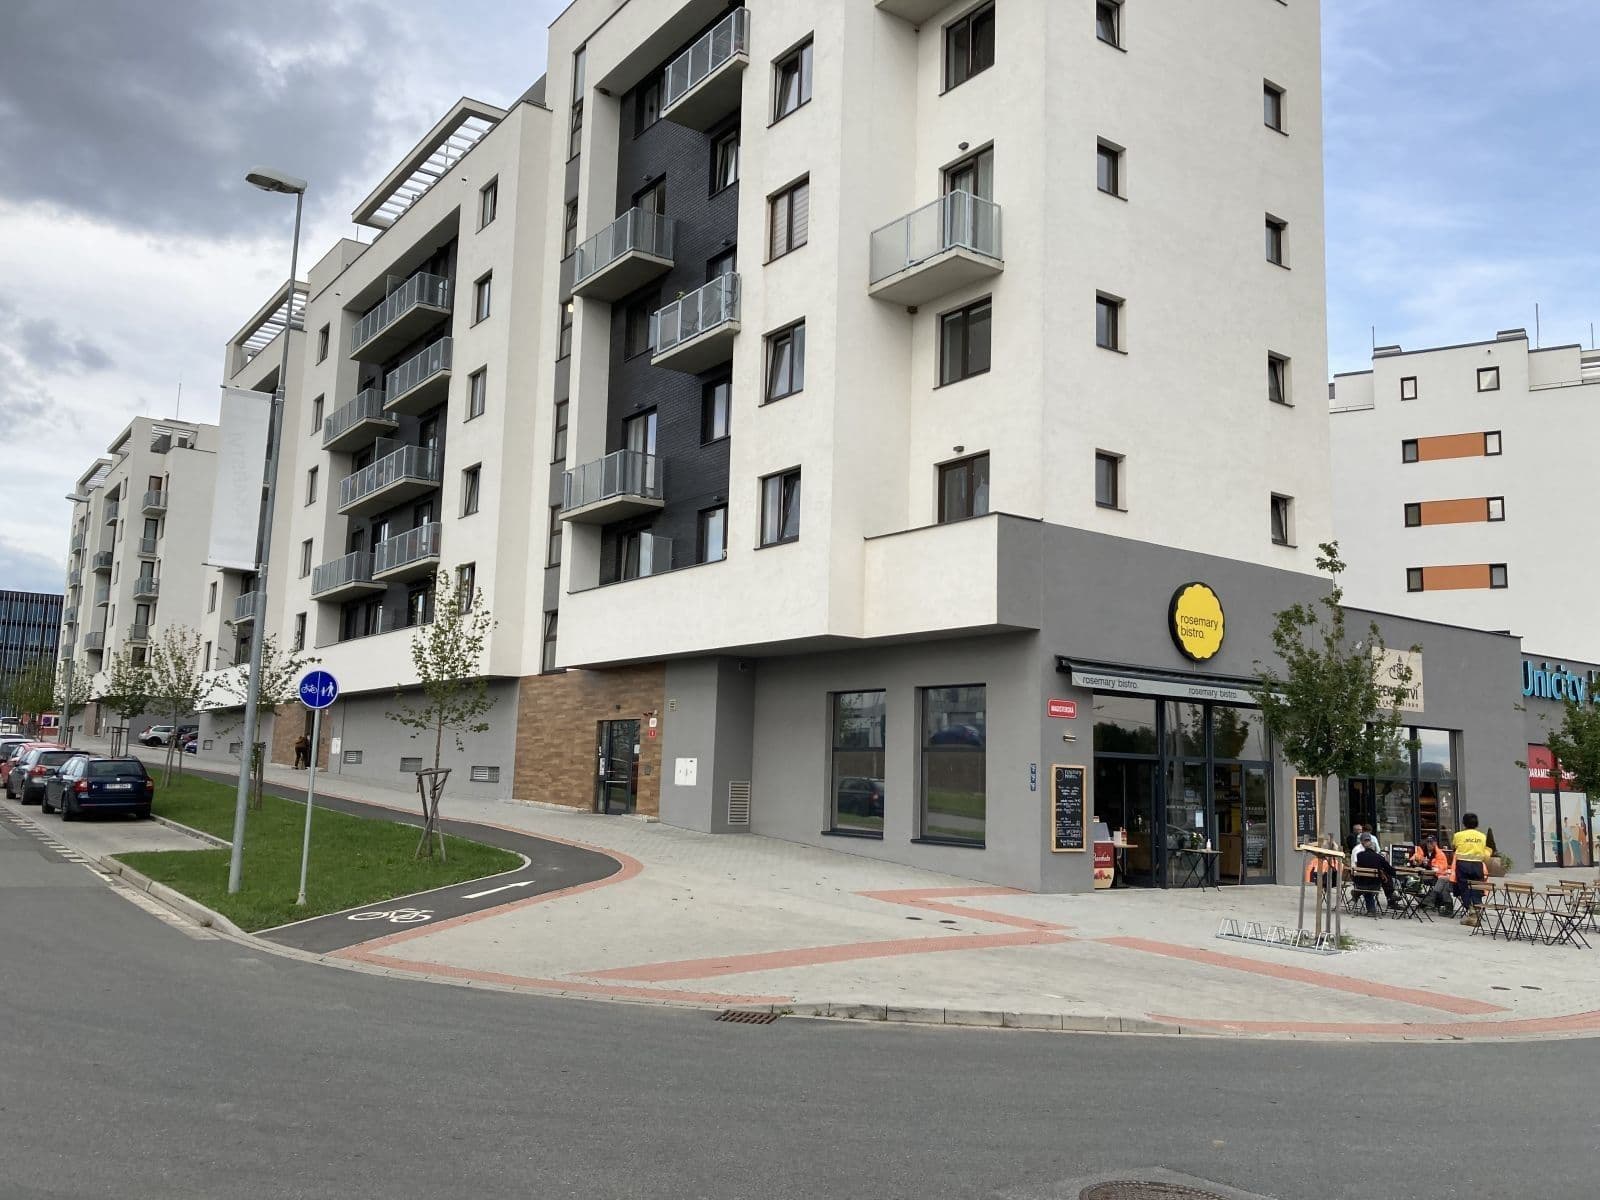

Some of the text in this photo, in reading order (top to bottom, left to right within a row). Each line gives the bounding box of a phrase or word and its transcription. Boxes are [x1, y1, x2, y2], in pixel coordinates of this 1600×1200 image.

[1181, 615, 1218, 631] rosemary
[1082, 675, 1116, 688] rosemary
[1522, 660, 1585, 711] Unicity
[1188, 687, 1218, 698] rosemary
